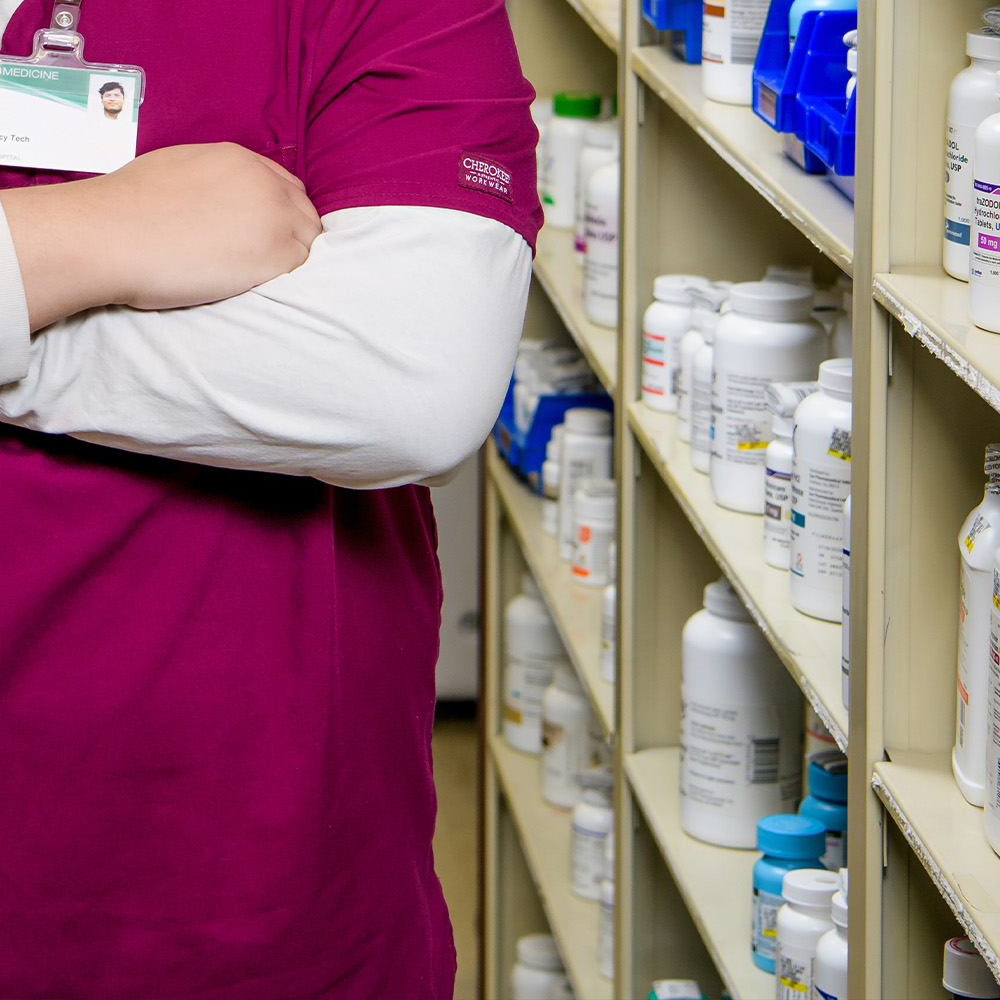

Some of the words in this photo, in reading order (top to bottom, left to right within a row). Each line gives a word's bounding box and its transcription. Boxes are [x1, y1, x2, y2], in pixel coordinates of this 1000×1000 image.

[2, 67, 59, 80] MEDICINE
[11, 134, 30, 142] Tech
[463, 157, 511, 184] CHEROKEE
[950, 162, 962, 172] USP
[465, 174, 508, 195] WORKWEAR
[980, 235, 987, 244] 50
[987, 238, 998, 249] mg
